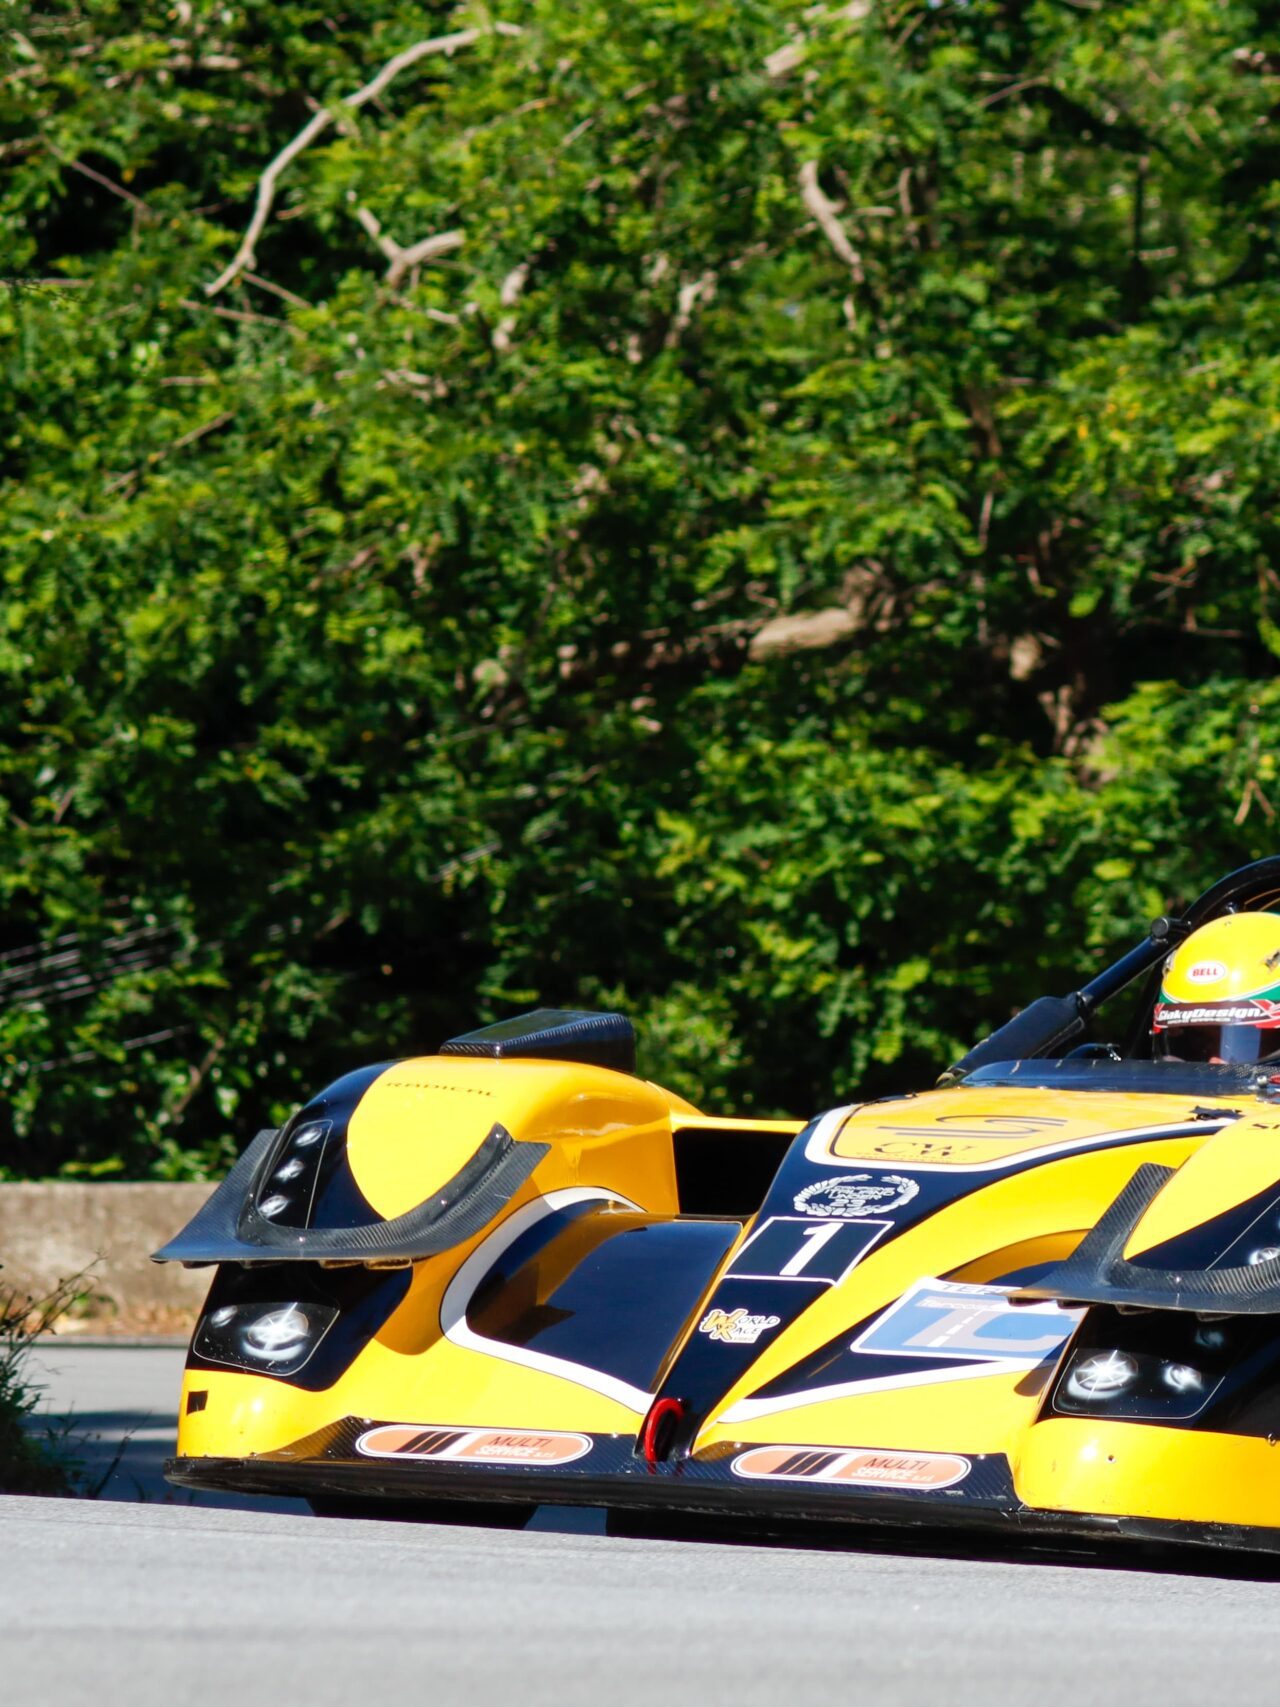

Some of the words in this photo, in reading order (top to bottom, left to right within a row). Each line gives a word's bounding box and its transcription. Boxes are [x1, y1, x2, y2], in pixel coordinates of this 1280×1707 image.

[1192, 967, 1218, 977] BELL
[386, 1081, 498, 1097] RADICAL
[780, 1223, 843, 1276] 1
[701, 1309, 779, 1331] WORLD
[712, 1322, 761, 1341] RACE
[489, 1435, 552, 1448] MULTI
[864, 1457, 930, 1470] MULTI
